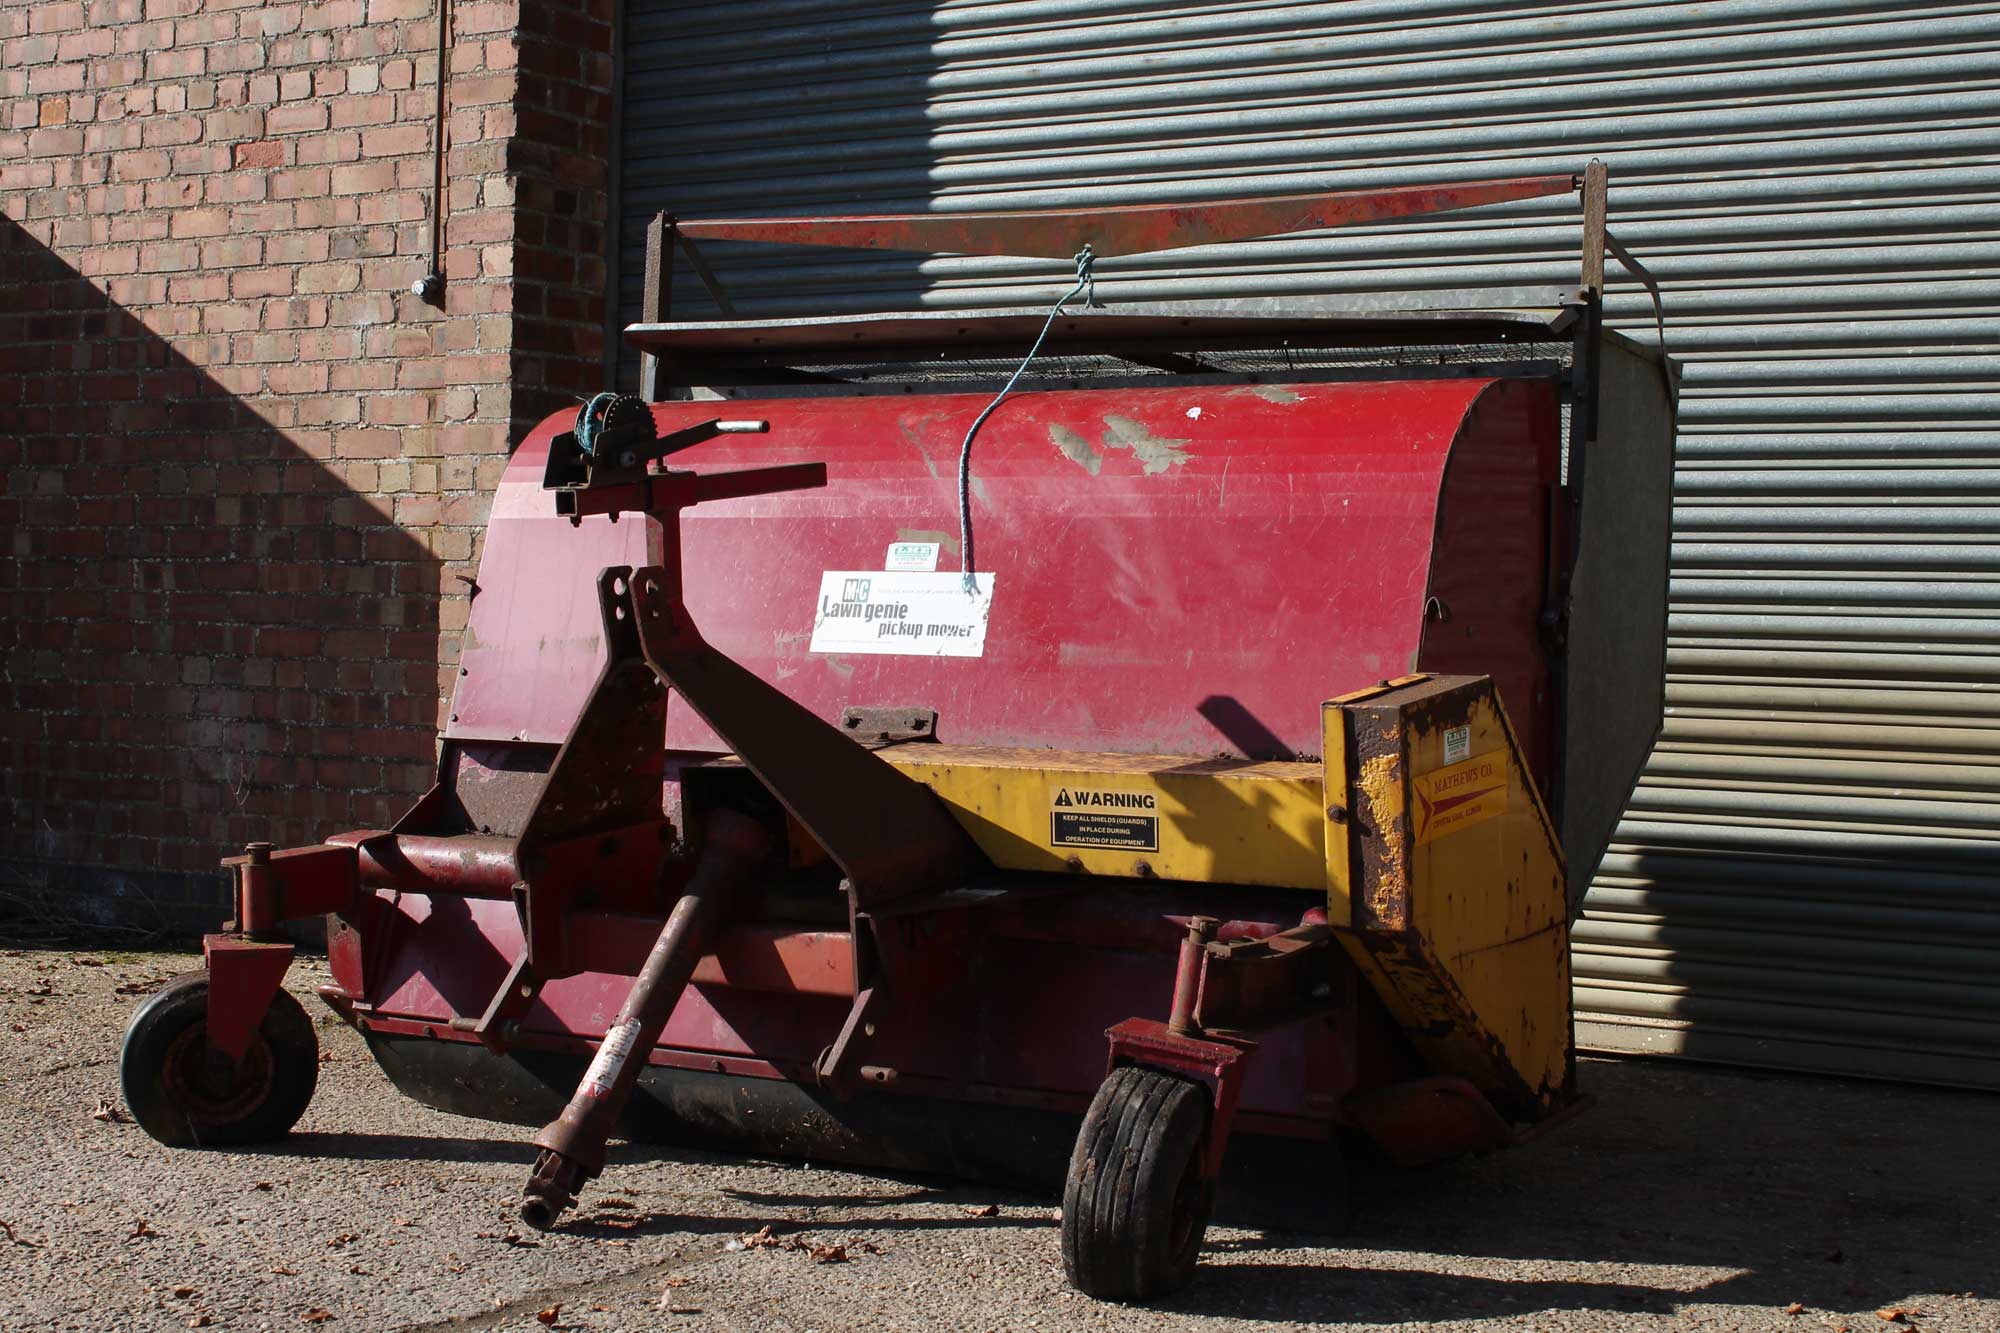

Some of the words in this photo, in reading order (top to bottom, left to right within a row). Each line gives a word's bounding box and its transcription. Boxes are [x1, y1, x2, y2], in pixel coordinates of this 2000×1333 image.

[823, 595, 862, 618] Lawn
[865, 601, 908, 622] genie
[878, 621, 923, 638] pickup
[926, 624, 975, 637] mower
[1434, 768, 1478, 794] MATHEWS
[1074, 792, 1155, 808] WARNING
[1090, 816, 1116, 824] SHIELDS
[1116, 818, 1147, 826] (GUARDS)
[1110, 838, 1145, 846] EQUIPMENT
